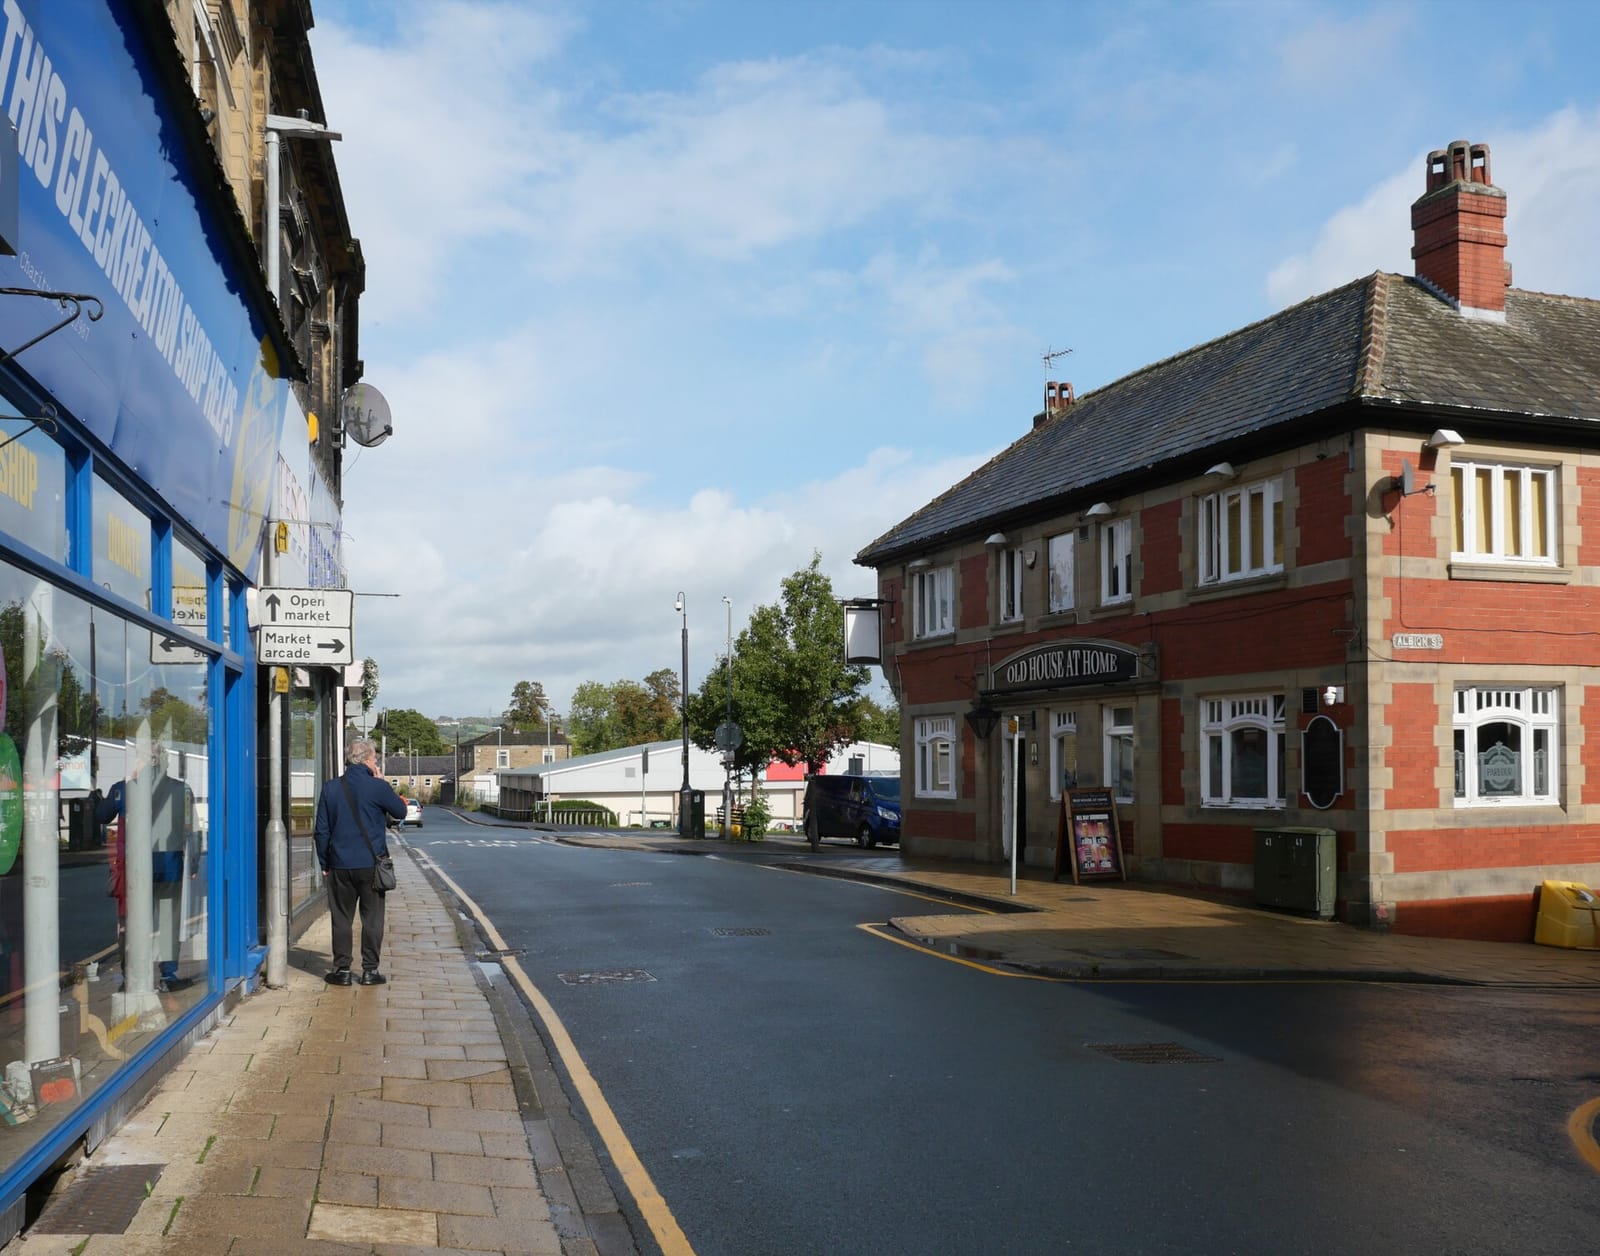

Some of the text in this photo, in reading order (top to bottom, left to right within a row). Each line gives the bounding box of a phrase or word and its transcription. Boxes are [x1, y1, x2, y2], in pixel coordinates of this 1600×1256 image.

[0, 0, 67, 188] THIS
[56, 107, 184, 366] CLECKHEATON
[174, 303, 212, 405] SHOP
[203, 349, 238, 448] HELPS
[0, 430, 38, 511] SHOP
[290, 594, 325, 608] Open
[284, 610, 331, 621] market
[265, 632, 312, 644] Market
[1397, 636, 1428, 647] ALBION
[265, 648, 311, 658] arcade
[1006, 649, 1118, 683] OLD HOUSE AT HOME
